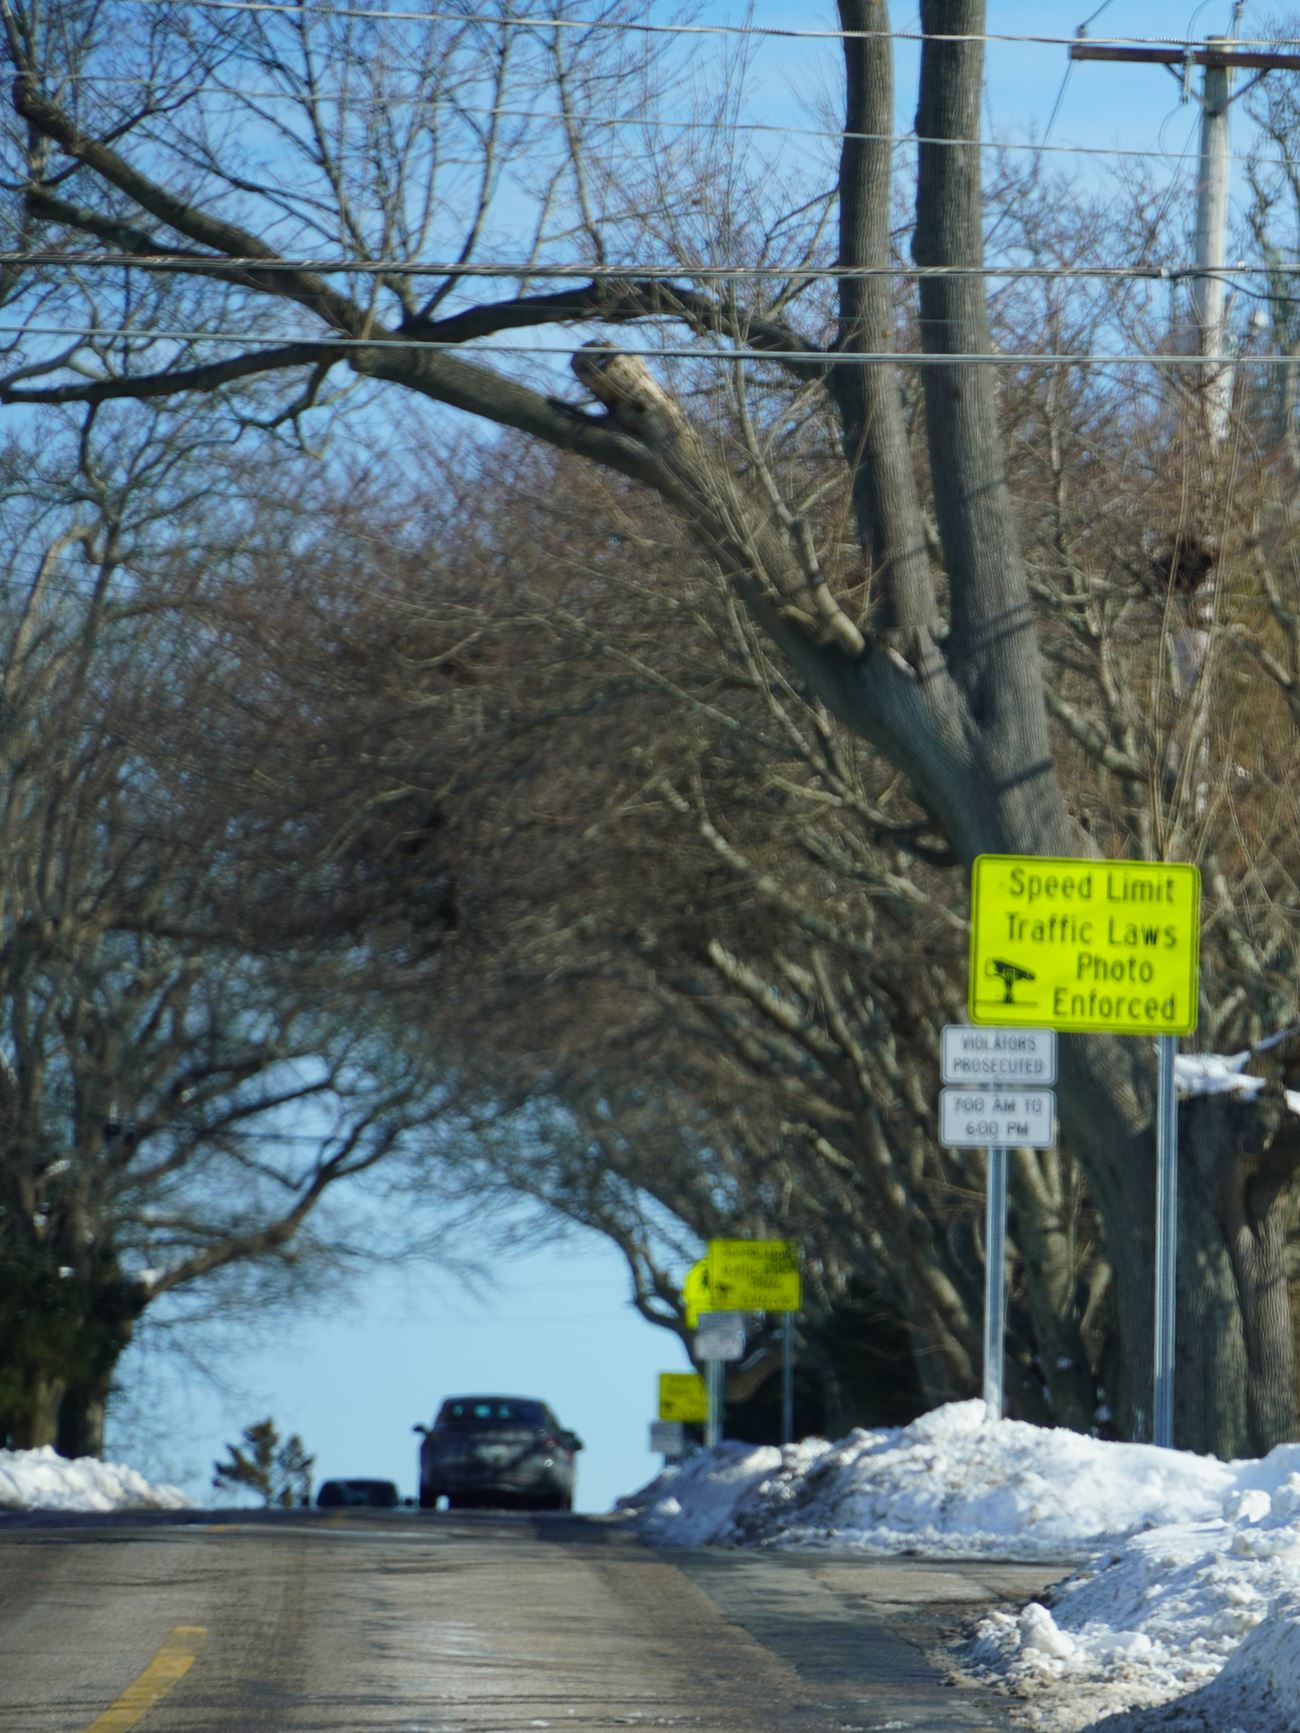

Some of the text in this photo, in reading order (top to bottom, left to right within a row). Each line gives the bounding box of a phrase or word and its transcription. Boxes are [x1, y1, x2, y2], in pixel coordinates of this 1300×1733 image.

[1009, 868, 1175, 903] Speed Limit
[1006, 912, 1177, 946] Traffic Laws
[1076, 952, 1154, 983] Photo
[1053, 987, 1176, 1020] Enforced
[961, 1034, 1036, 1051] VIOLATORS
[954, 1055, 1044, 1073] PROSECUTED
[992, 1098, 1016, 1113] AM
[1024, 1098, 1042, 1113] TO
[1007, 1121, 1029, 1136] PM
